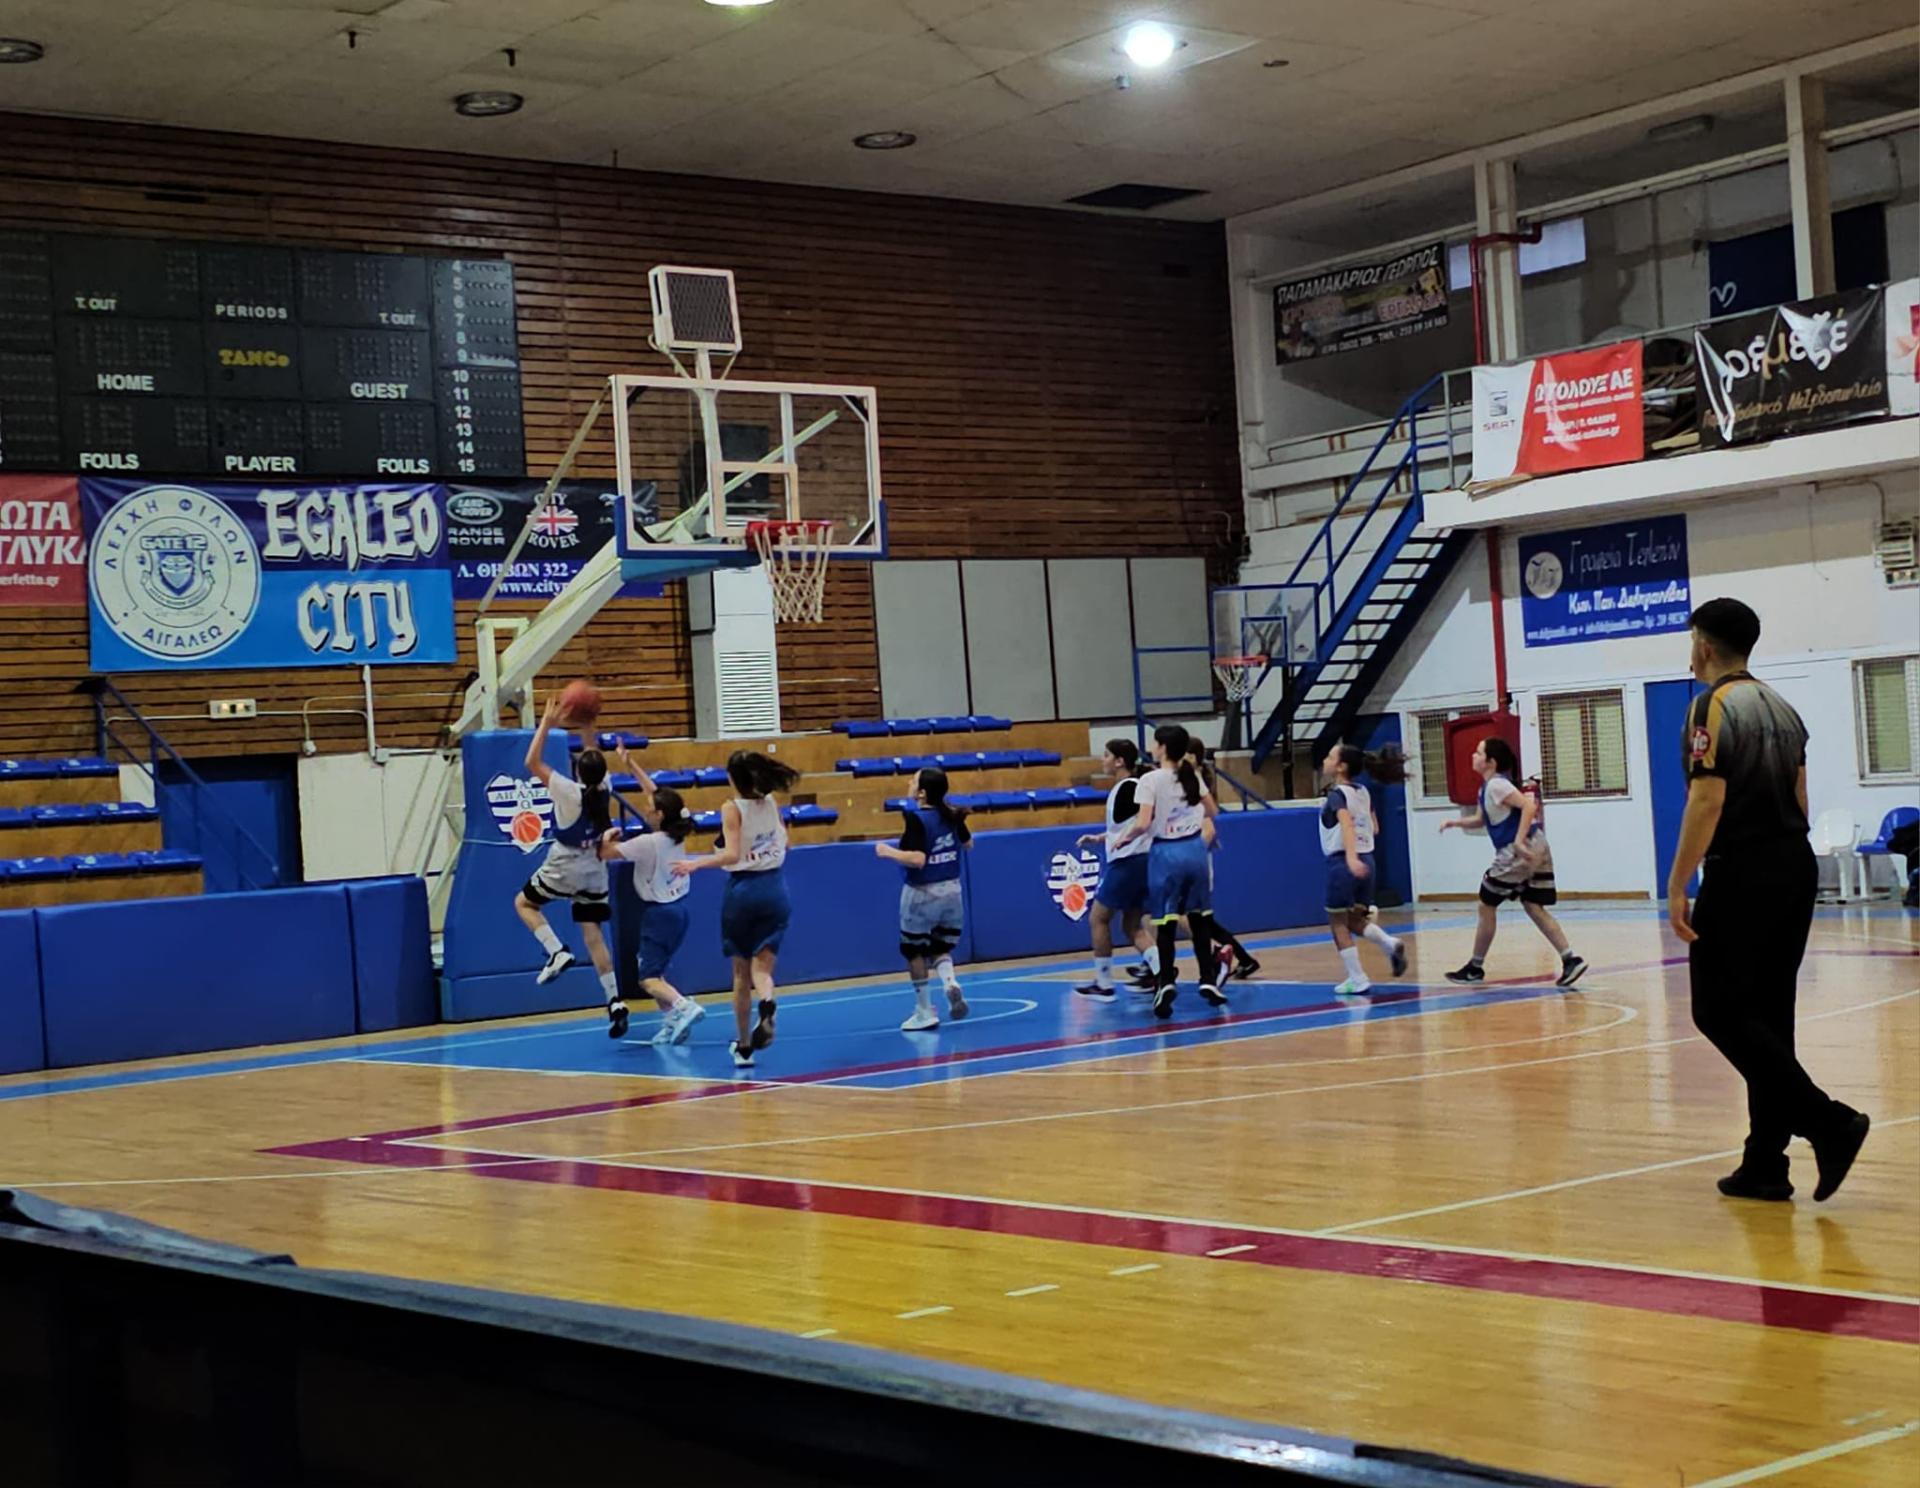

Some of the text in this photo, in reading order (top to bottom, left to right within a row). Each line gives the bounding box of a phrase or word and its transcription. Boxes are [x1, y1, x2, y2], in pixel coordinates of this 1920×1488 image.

[452, 260, 462, 272] 4
[453, 277, 463, 290] 5
[1278, 266, 1384, 305] ΠΑΠΑΜΑΚΑΡΙΟΣ
[453, 295, 464, 308] 6
[215, 304, 288, 319] PERIODS
[454, 313, 465, 326] 7
[455, 331, 466, 344] 8
[456, 349, 467, 363] 9
[97, 373, 155, 392] HOME
[452, 369, 470, 383] 10
[1610, 366, 1634, 392] ΑΕ
[350, 382, 409, 400] GUEST
[453, 387, 470, 401] 11
[454, 406, 472, 419] 12
[455, 423, 473, 437] 13
[456, 441, 474, 455] 14
[79, 451, 140, 470] FOULS
[224, 455, 297, 472] PLAYER
[376, 457, 431, 475] FOULS
[457, 459, 476, 473] 15
[533, 492, 569, 506] CTY
[0, 500, 72, 530] ΩΤΑ
[256, 488, 440, 572] EGALEO
[447, 527, 504, 536] RANGE
[447, 537, 506, 545] ROVER
[528, 532, 580, 549] ROVER
[457, 563, 475, 578] Λ.
[542, 562, 569, 577] 322
[142, 624, 224, 649] ΑΙΓΑΛΕΩ
